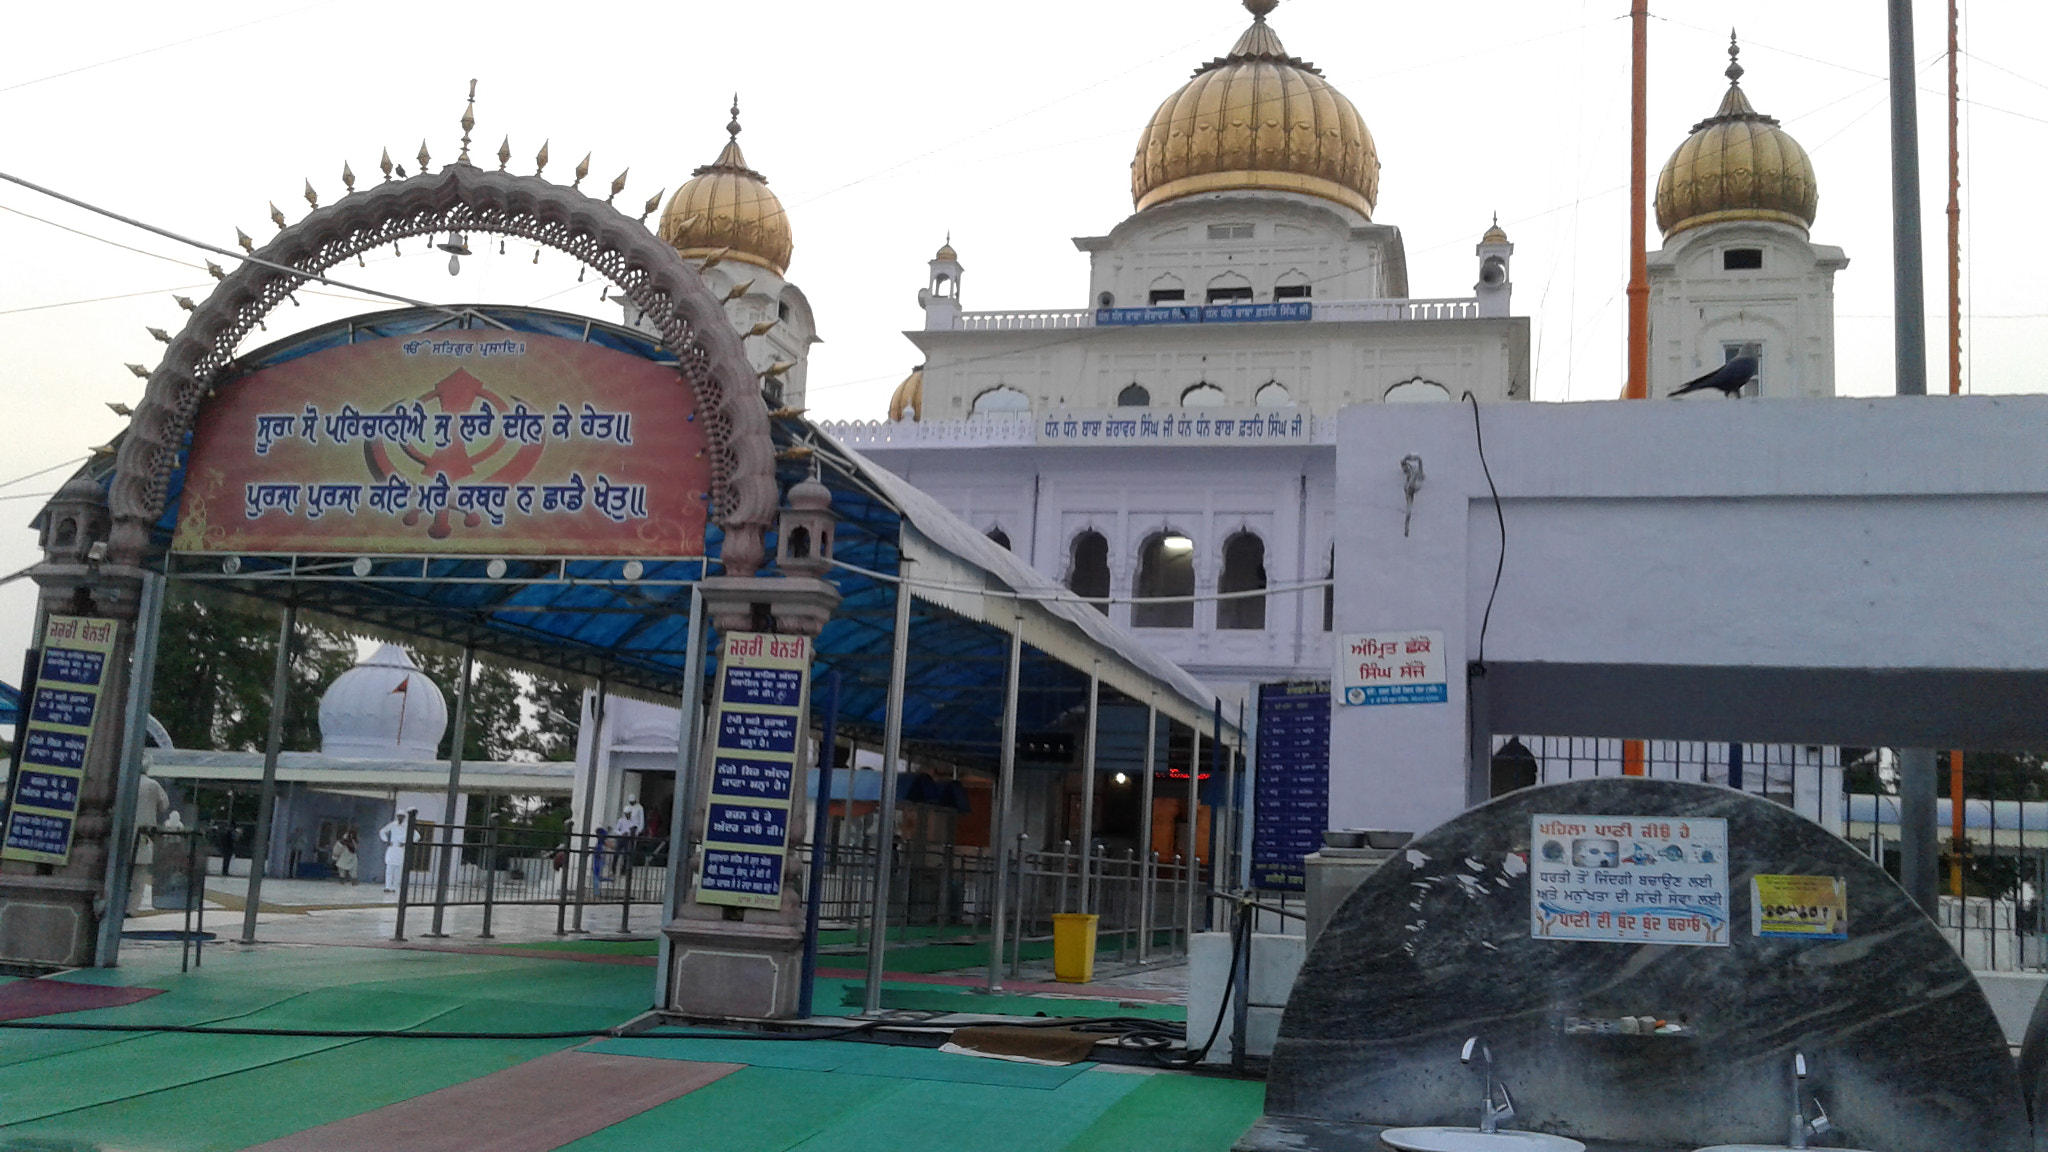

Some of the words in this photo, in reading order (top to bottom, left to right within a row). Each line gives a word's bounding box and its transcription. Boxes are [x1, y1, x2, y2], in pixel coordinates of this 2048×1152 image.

[432, 340, 474, 356] ਸਤਿਗੁਰ
[257, 415, 296, 454] ਸੂਰਾ
[301, 402, 318, 443] ਸੋ
[434, 414, 453, 447] ਜੁ
[459, 402, 495, 442] ਲਰੈ
[502, 403, 545, 443] ਦੀਨ
[552, 404, 573, 440] ਕੇ
[1045, 413, 1059, 438] ਧੰਨ
[1064, 413, 1078, 438] ਧੰਨ
[1082, 420, 1102, 437] ਬਾਬਾ
[1140, 412, 1159, 437] ਸਿੰਘ
[1162, 413, 1174, 437] ਜੀ
[1178, 412, 1192, 437] ਧੰਨ
[1196, 412, 1211, 437] ਧੰਨ
[1214, 420, 1235, 436] ਬਾਬਾ
[1268, 412, 1287, 437] ਸਿੰਘ
[1291, 413, 1302, 437] ਜੀ
[246, 485, 301, 517] ਪੁਰਜਾ
[307, 485, 362, 517] ਪੁਰਜਾ
[419, 472, 450, 514] ਮਰੈ
[457, 486, 509, 525] ਕਬਹੂ
[516, 486, 535, 513] ਨ
[542, 473, 586, 510] ਛਾਡੈ
[82, 620, 111, 643] ਬੇਨਤੀ
[769, 634, 804, 659] ਬੇਨਤੀ
[1360, 662, 1392, 680] ਸਿੰਘ
[764, 767, 790, 779] ਅੰਦਰ
[713, 821, 739, 832] ਅੰਦਰ
[1539, 821, 1586, 836] ਪਹਿਲਾ
[1594, 823, 1633, 838] ਪਾਣੀ
[1679, 822, 1690, 838] ਹੈ
[1540, 870, 1571, 884] ਧਰਤੀ
[1688, 874, 1713, 889] ਲਈ
[1536, 886, 1558, 901] ਅਤੇ
[1615, 889, 1630, 903] ਦੀ
[1635, 890, 1662, 905] ਸੱਚੀ
[1668, 889, 1692, 905] ਸੇਵਾ
[1698, 892, 1723, 906] ਲਈ
[1559, 911, 1590, 928] ਪਾਣੀ
[1597, 911, 1611, 929] ਦੀ
[1618, 911, 1636, 937] ਬੂੰਦ
[1643, 912, 1661, 937] ਬੂੰਦ
